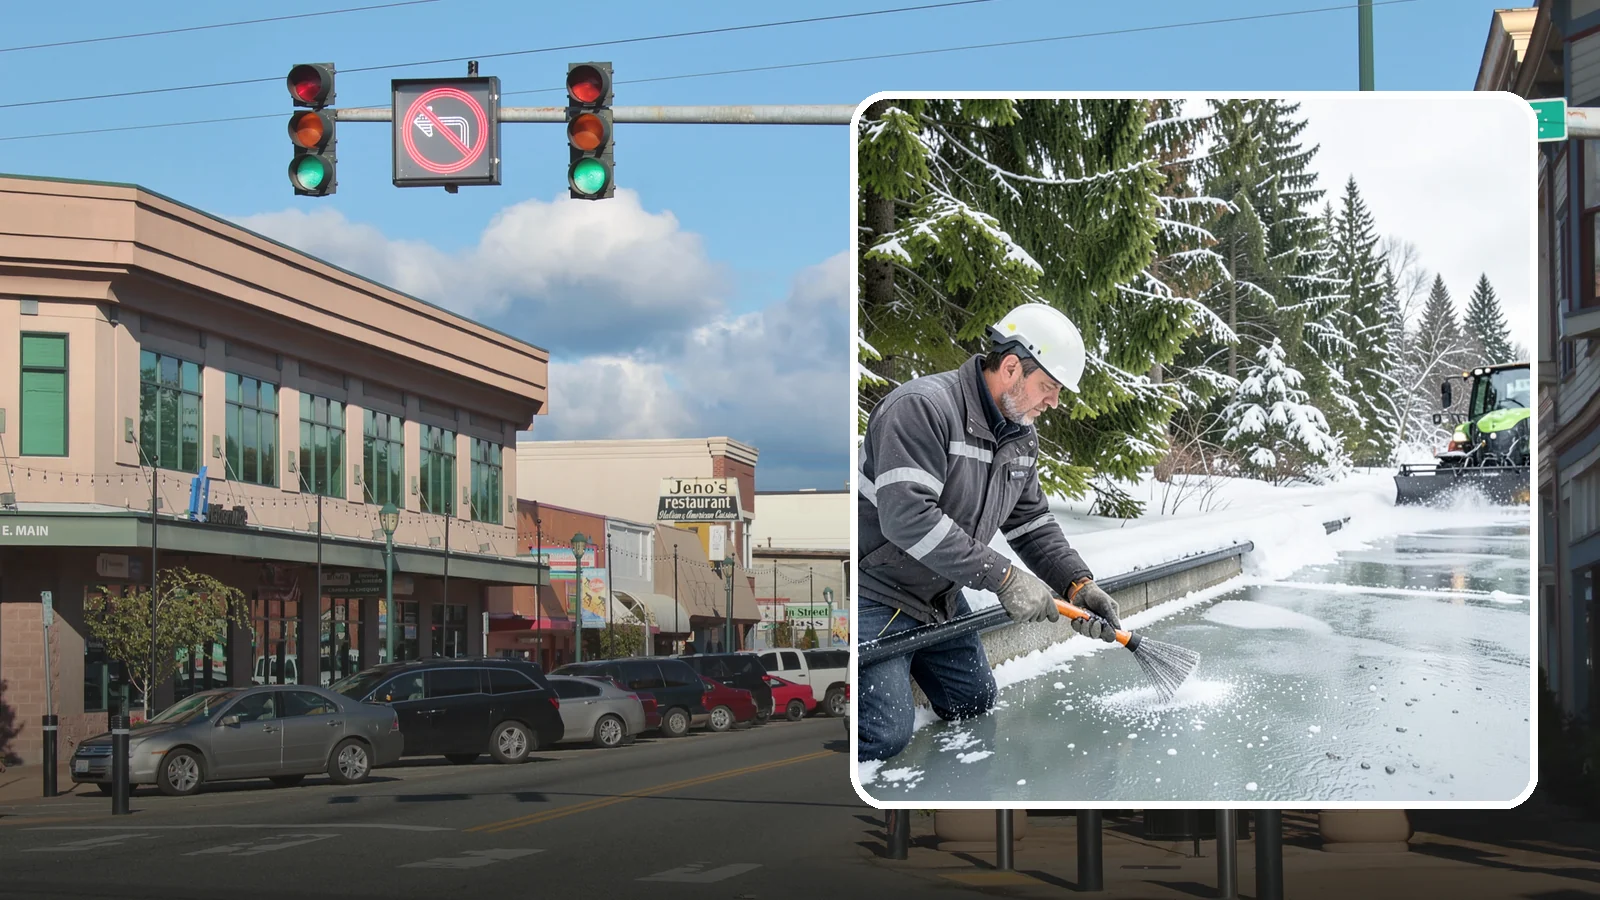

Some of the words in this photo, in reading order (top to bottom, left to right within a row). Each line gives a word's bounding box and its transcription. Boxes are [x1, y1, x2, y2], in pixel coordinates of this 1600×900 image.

[670, 480, 727, 494] Jeno's
[665, 496, 731, 509] restaurant
[686, 509, 714, 519] American
[714, 509, 738, 519] Cuisine
[2, 525, 13, 536] E.
[15, 525, 49, 536] MAIN
[797, 607, 828, 616] Street
